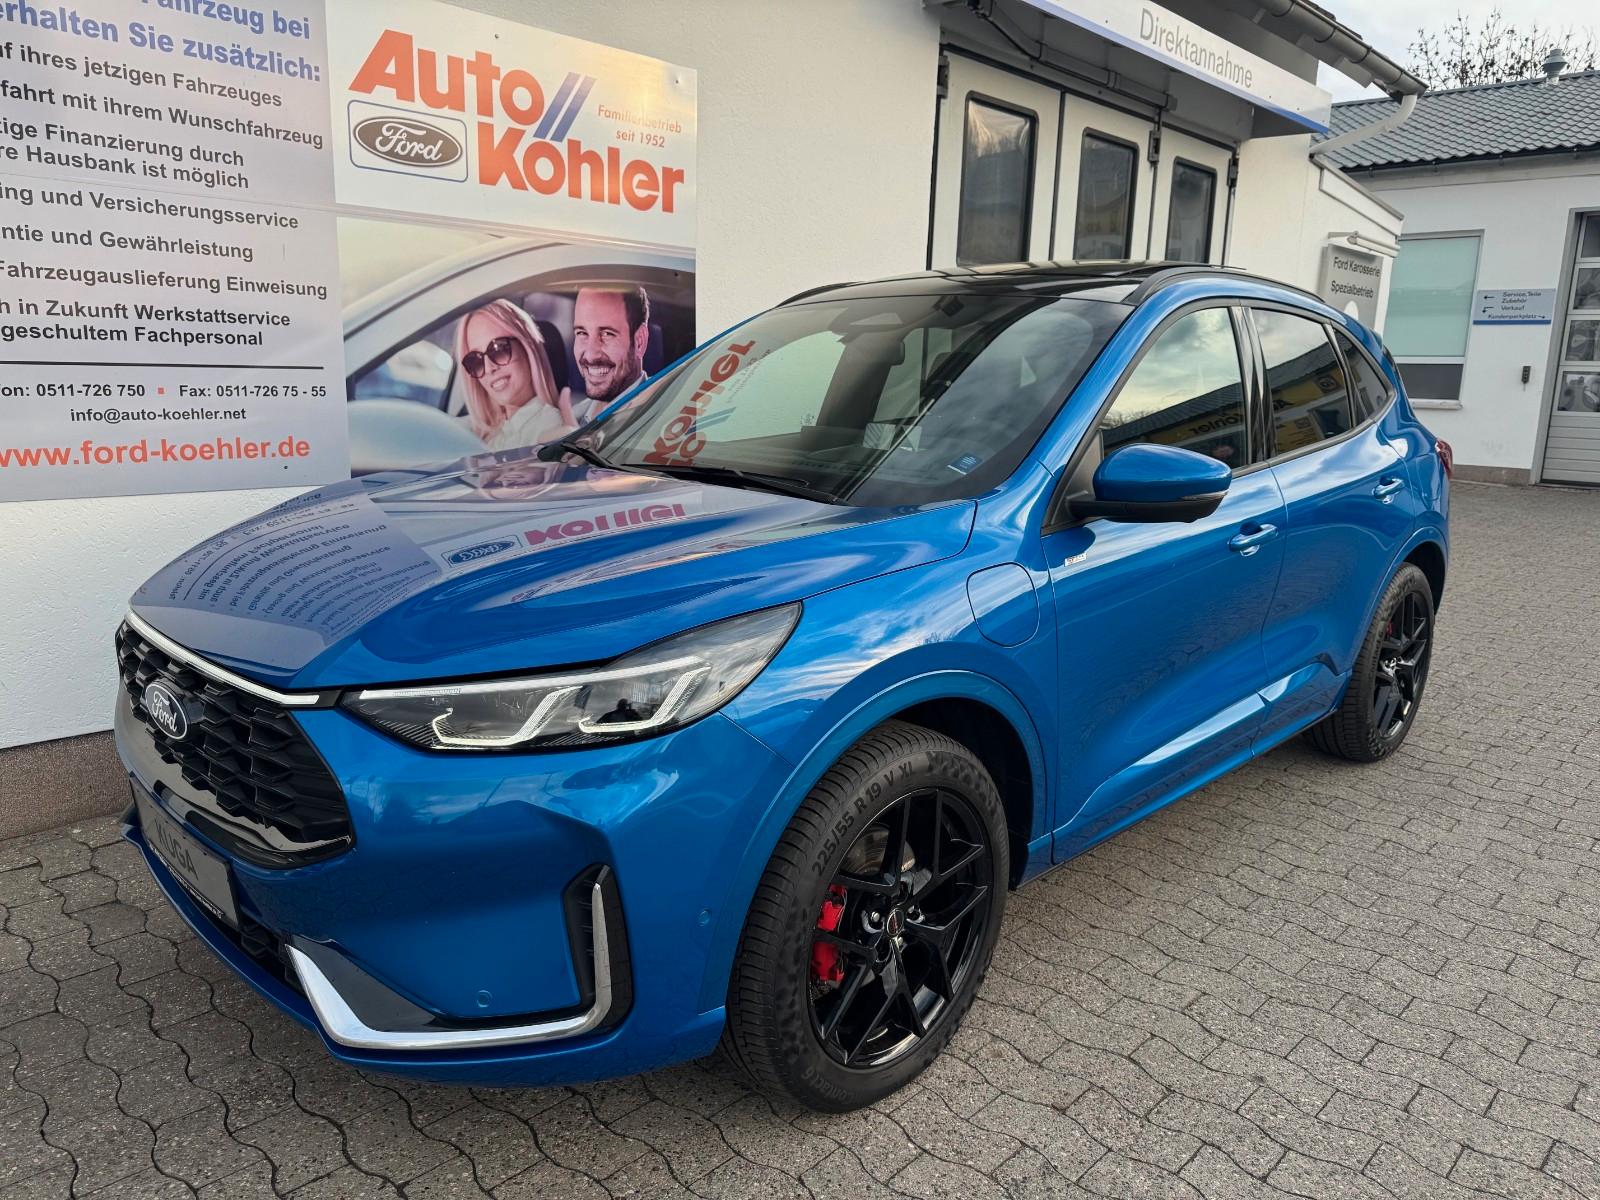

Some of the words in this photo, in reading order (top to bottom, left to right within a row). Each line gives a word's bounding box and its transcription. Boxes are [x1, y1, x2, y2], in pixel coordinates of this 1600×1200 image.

[141, 0, 264, 34] rzeug
[273, 10, 310, 39] bei
[0, 0, 118, 42] rhalten
[128, 22, 174, 52] Sie
[182, 38, 321, 82] zusätzlich:
[1140, 8, 1253, 88] Direktannahme
[20, 45, 78, 71] ihres
[83, 56, 167, 87] jetzigen
[173, 72, 283, 107] Fahrzeuges
[349, 29, 545, 126] Auto
[0, 80, 55, 105] fahrt
[62, 91, 98, 112] mit
[103, 97, 163, 121] ihrem
[168, 106, 324, 150] Wunschfahrzeug
[597, 104, 682, 134] Familienbetrieb
[45, 123, 183, 161] Finanzierung
[189, 145, 244, 166] durch
[375, 122, 443, 162] Ford
[615, 128, 637, 144] seit
[639, 132, 666, 149] 1952
[26, 145, 136, 175] Hausbank
[142, 160, 168, 179] ist
[173, 166, 249, 189] möglich
[41, 188, 83, 207] und
[89, 191, 299, 229] Versicherungsservice
[1, 224, 44, 242] ntie
[51, 229, 93, 246] und
[99, 231, 254, 262] Gewährleistung
[1333, 256, 1348, 271] Ford
[1349, 260, 1380, 278] Karosserie
[226, 276, 328, 300] Einweisung
[1330, 280, 1374, 298] Spezialbetrieb
[18, 298, 39, 316] in
[46, 299, 129, 320] Zukunft
[134, 304, 291, 326] Werkstattservice
[1, 323, 128, 342] geschultem
[134, 326, 264, 347] Fachpersonal
[0, 383, 30, 398] on:
[36, 384, 113, 398] 0511-726
[116, 384, 145, 397] 750
[179, 385, 212, 398] Fax:
[216, 385, 279, 398] 0511-726
[282, 385, 299, 397] 75
[311, 385, 327, 397] 55
[70, 407, 247, 424] info@auto-koehler.net
[152, 691, 177, 732] Ford
[812, 811, 855, 876] 225/55
[854, 797, 867, 814] R
[865, 782, 882, 800] 19
[884, 770, 894, 787] V
[156, 820, 199, 881] KUGA
